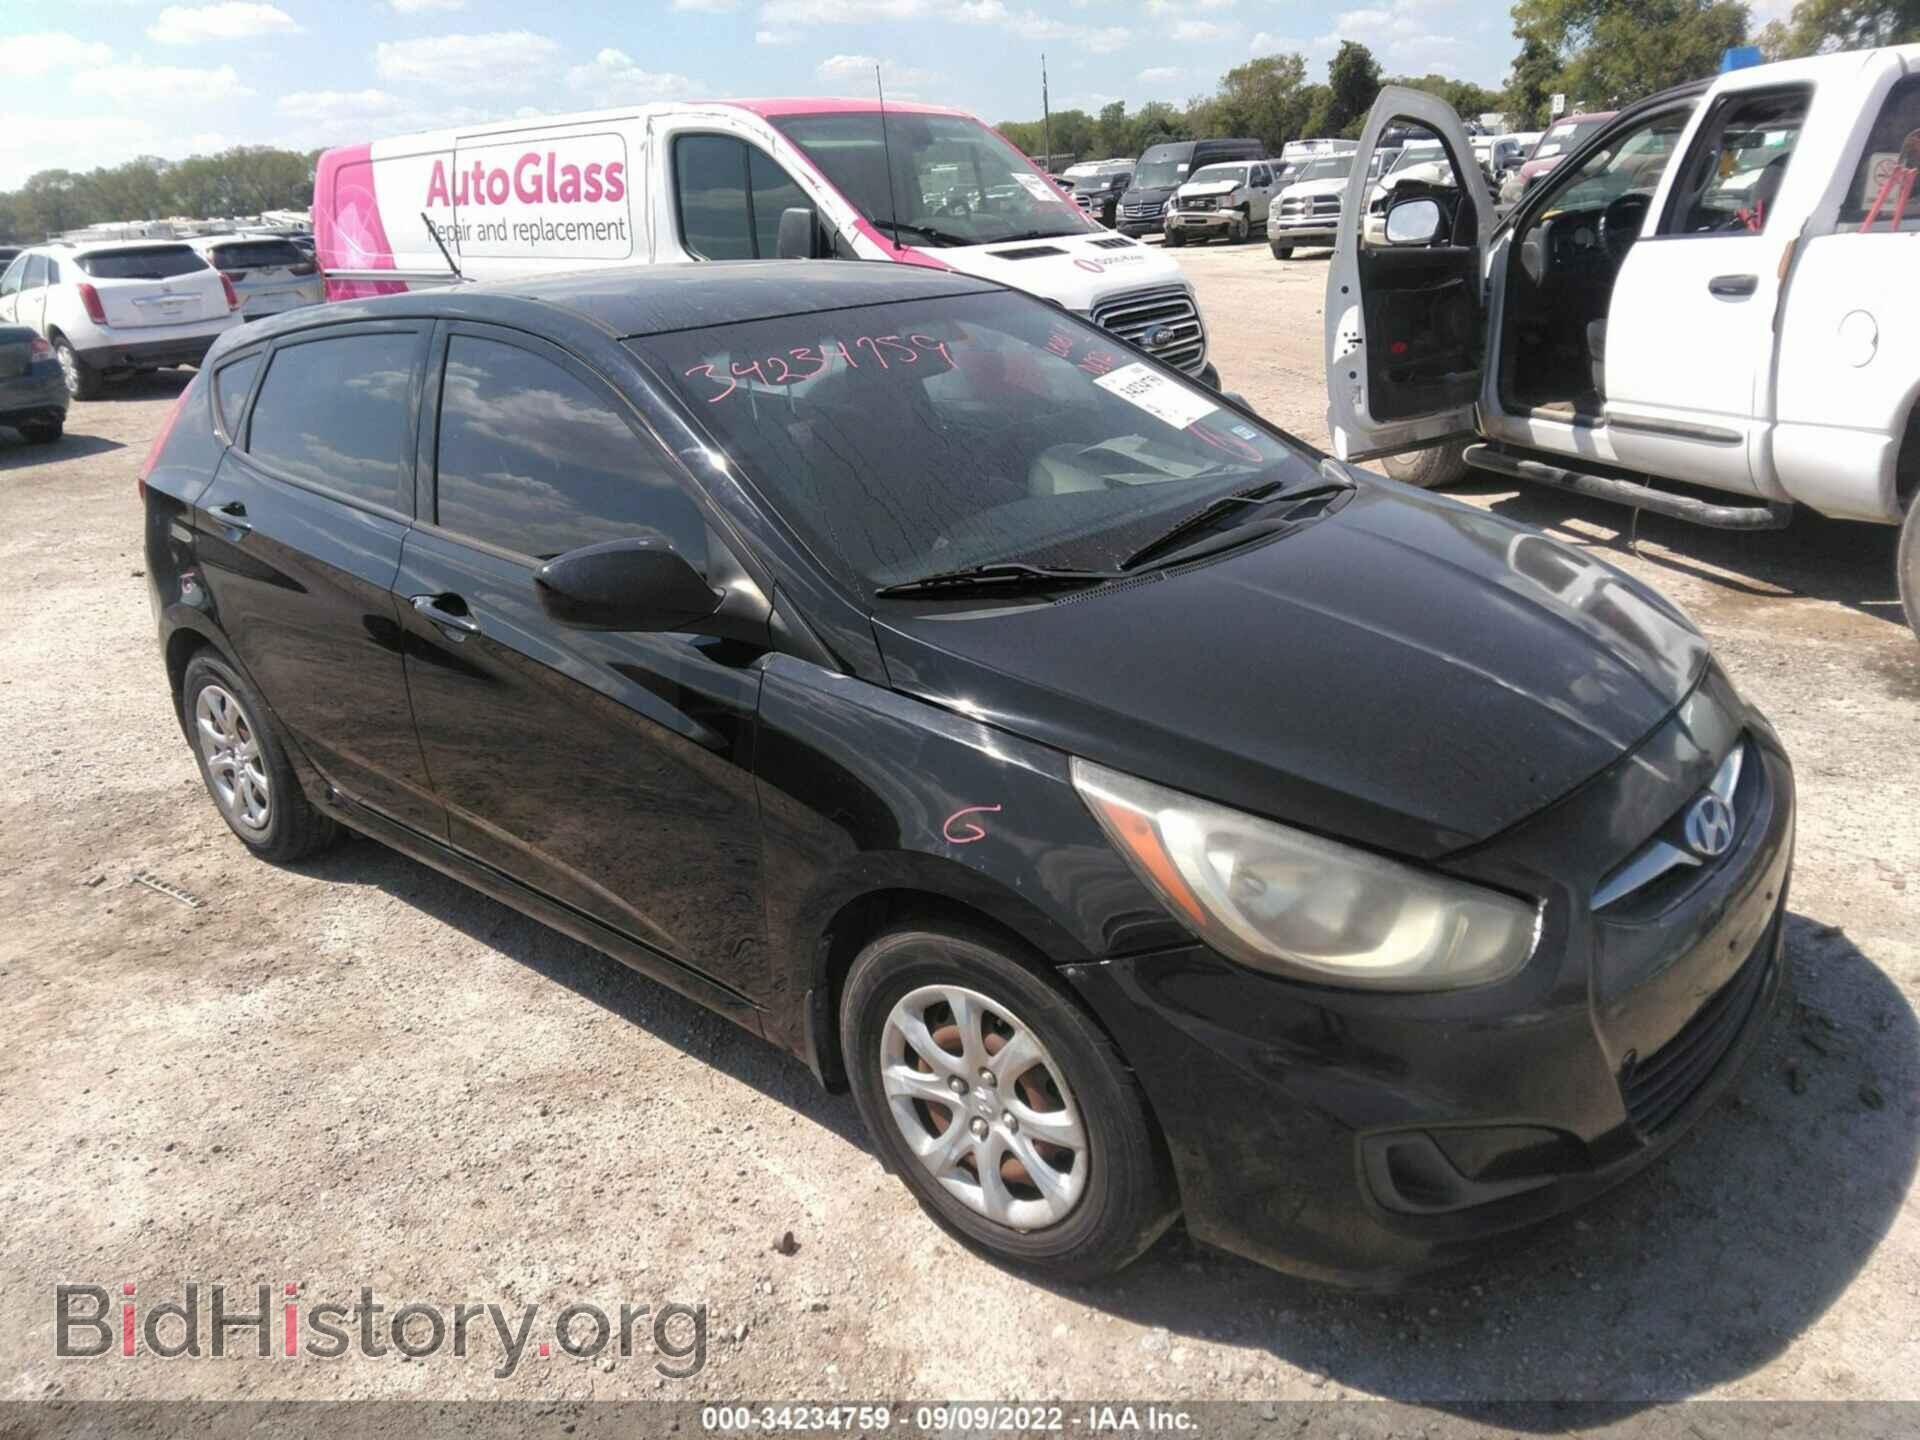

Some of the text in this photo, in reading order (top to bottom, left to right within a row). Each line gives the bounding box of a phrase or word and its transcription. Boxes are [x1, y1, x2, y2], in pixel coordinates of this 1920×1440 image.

[426, 152, 625, 208] AutoGlass
[477, 216, 507, 241] and
[513, 217, 627, 247] replacement
